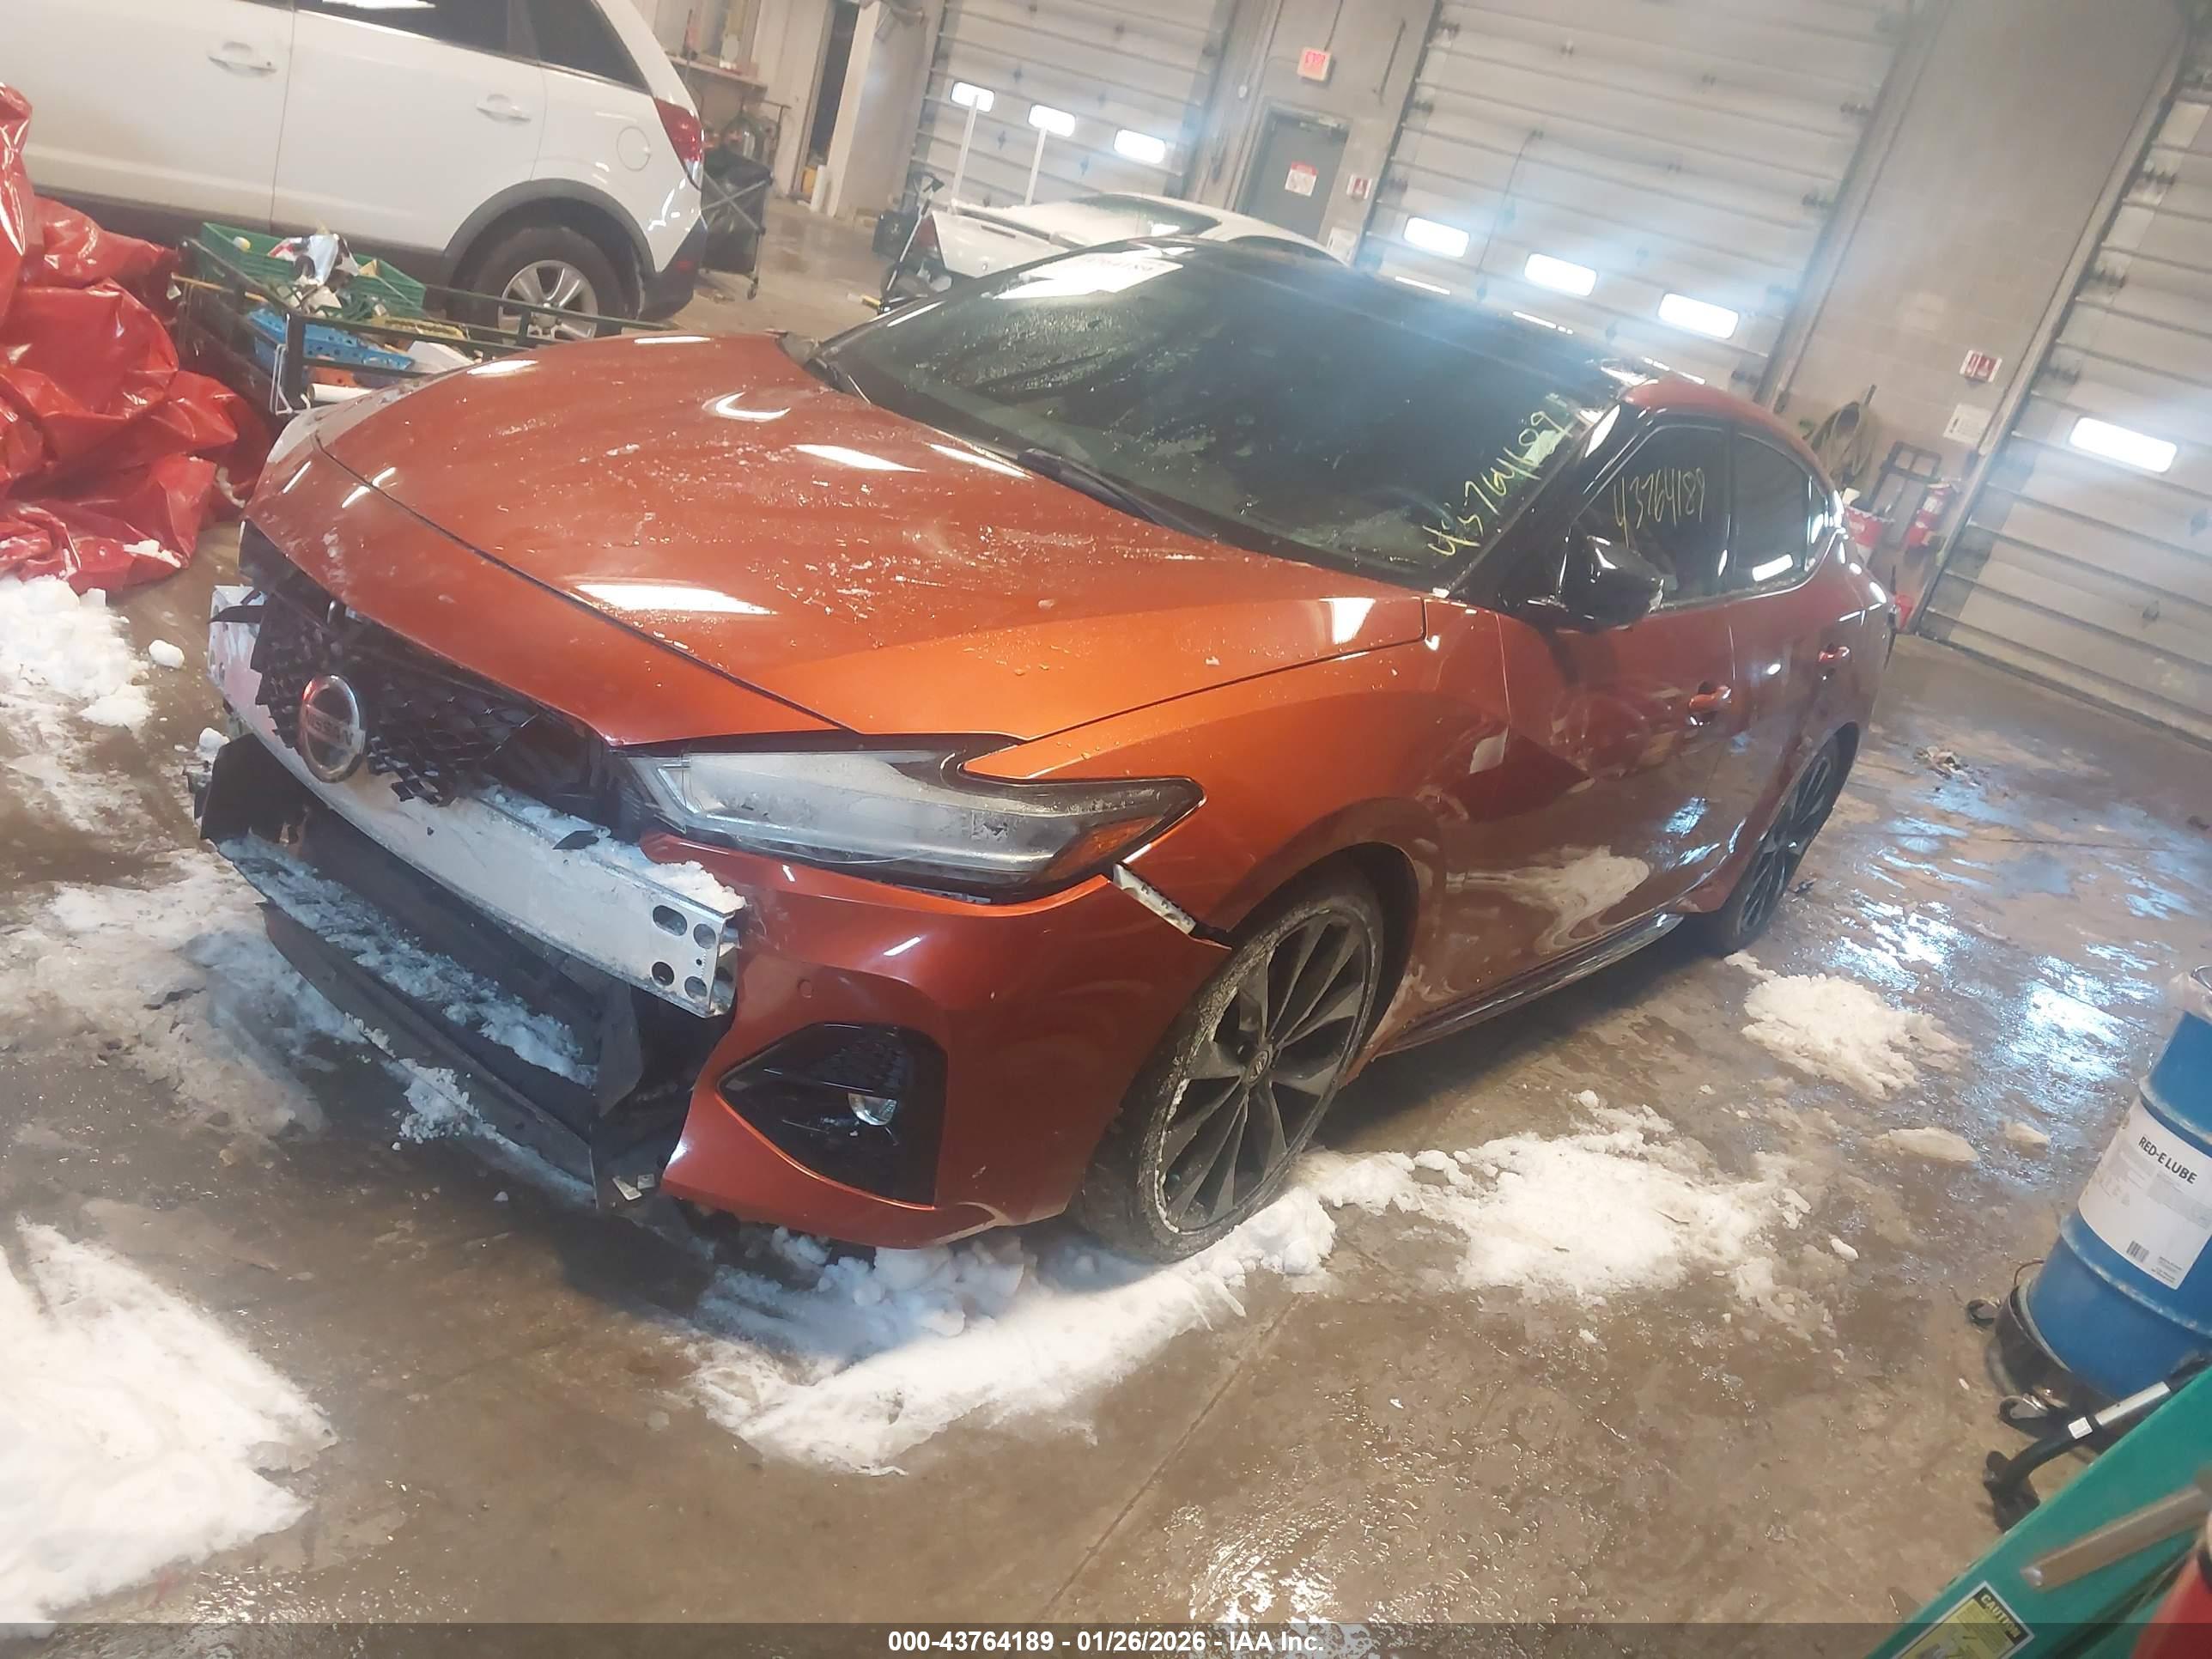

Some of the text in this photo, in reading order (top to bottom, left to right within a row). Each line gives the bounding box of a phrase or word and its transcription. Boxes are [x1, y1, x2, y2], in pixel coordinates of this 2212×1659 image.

[1613, 466, 1705, 549] 43764189
[2138, 1136, 2167, 1164] RED-E
[2164, 1157, 2197, 1184] LUBE
